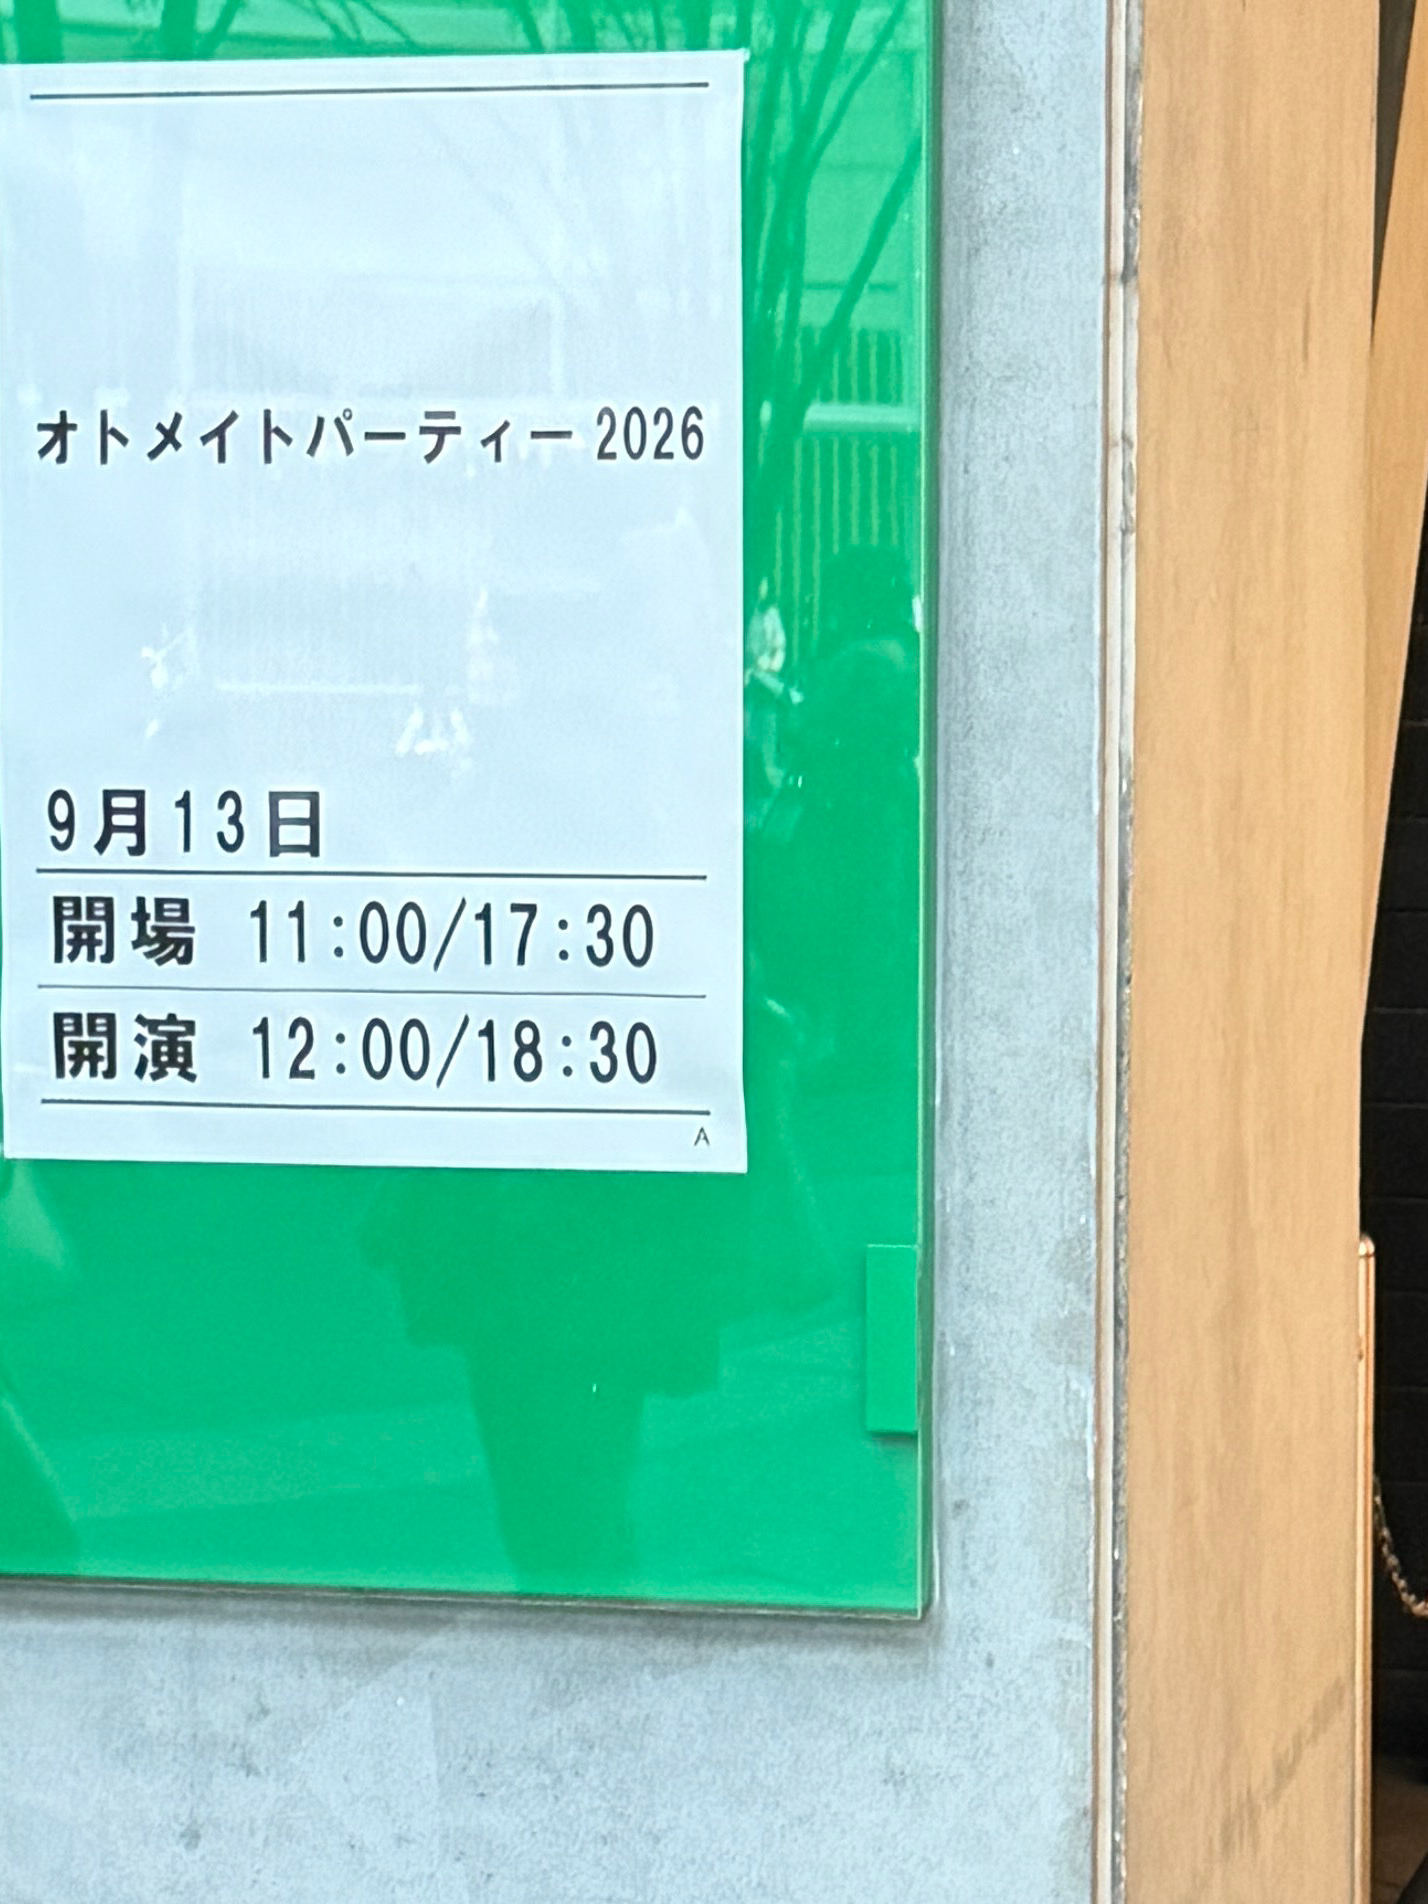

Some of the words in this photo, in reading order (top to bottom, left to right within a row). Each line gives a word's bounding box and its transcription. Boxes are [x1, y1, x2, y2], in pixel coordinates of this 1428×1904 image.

[36, 408, 574, 465] オトメイトパーティー
[596, 406, 705, 462] 2026
[47, 788, 321, 858] 9月13日
[52, 895, 197, 967] 開場
[250, 897, 655, 972] 11:00/17:30
[53, 1011, 199, 1084] 開演
[252, 1014, 658, 1089] 12:00/18:30
[694, 1126, 711, 1147] A
